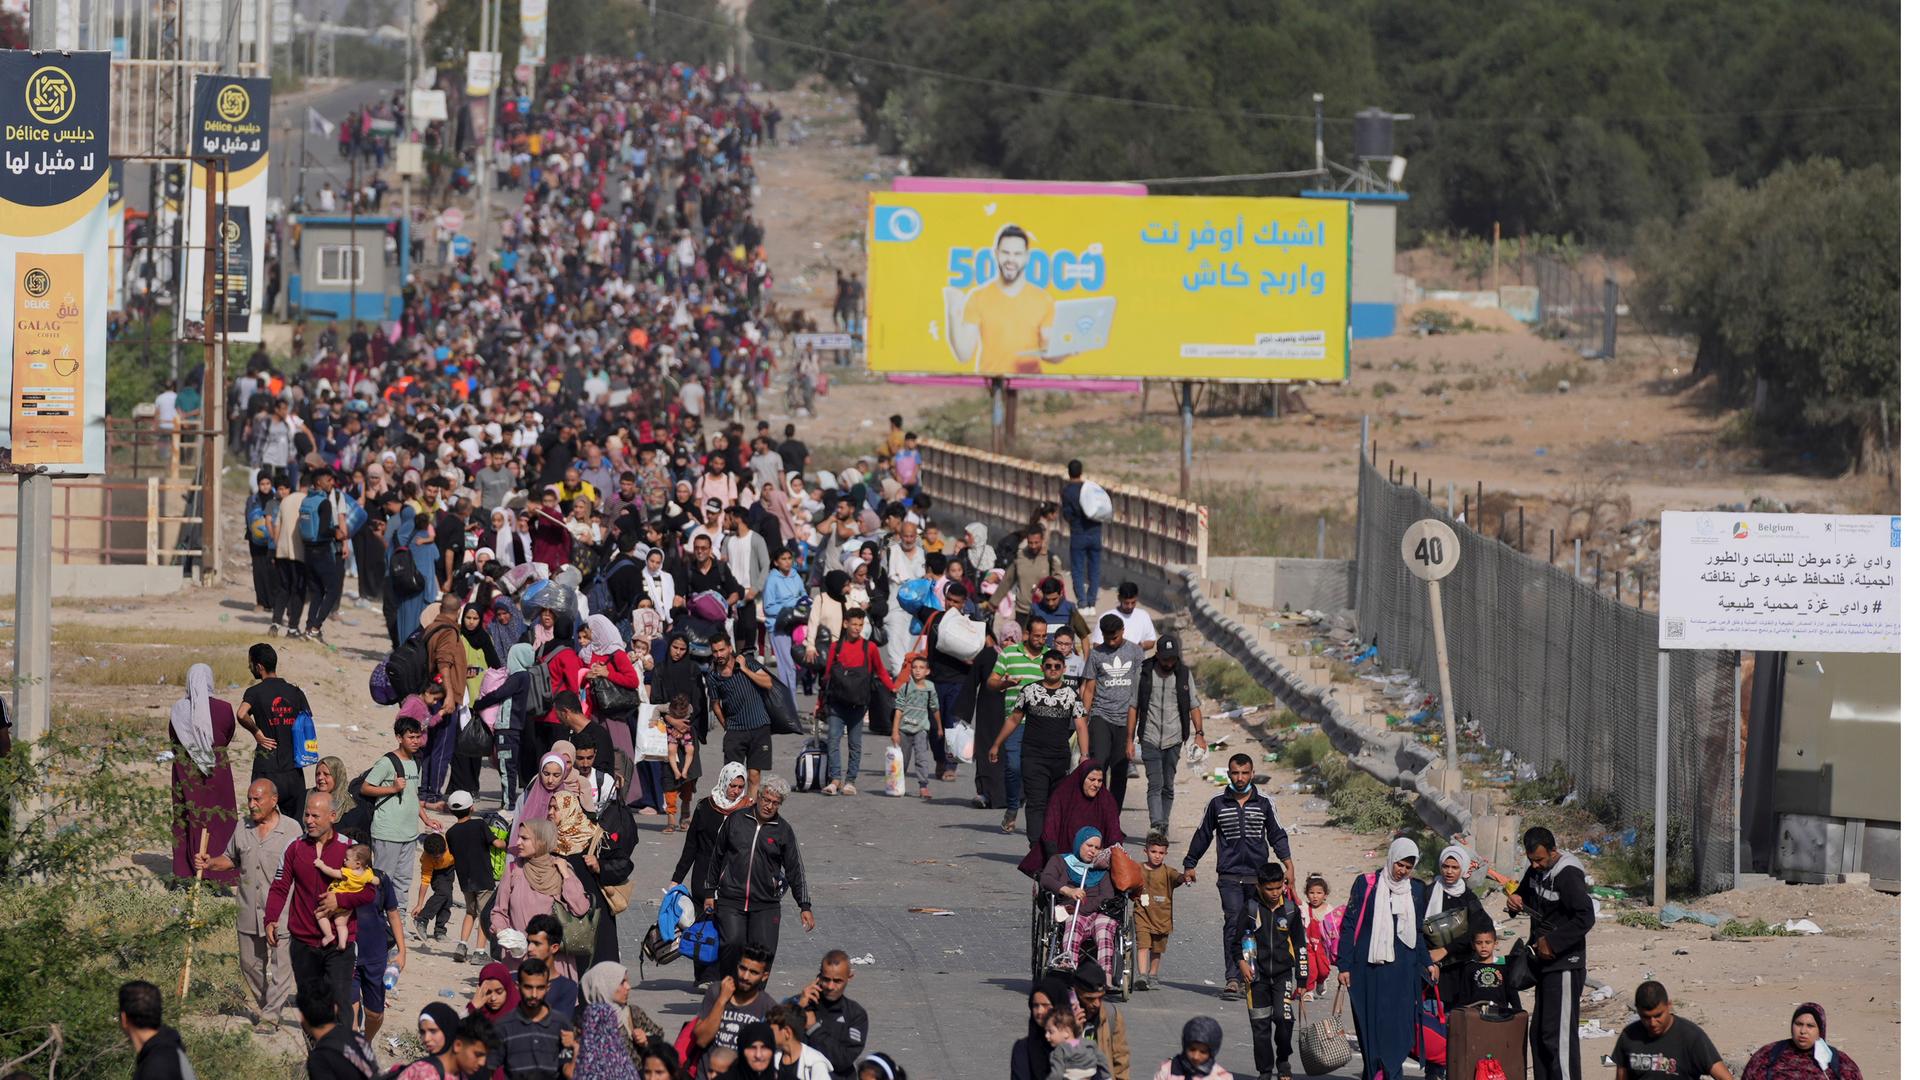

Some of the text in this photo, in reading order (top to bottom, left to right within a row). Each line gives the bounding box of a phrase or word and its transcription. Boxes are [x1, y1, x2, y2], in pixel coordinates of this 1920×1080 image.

[6, 125, 95, 143] Délice ديليس
[204, 120, 233, 132] Délice
[203, 136, 261, 154] لا مثيل لها
[6, 149, 95, 175] لا مثيل لها
[1140, 213, 1325, 253] اشبك أوفر نت
[1183, 258, 1325, 296] واربح كاش
[18, 320, 60, 331] GALAG
[1758, 523, 1794, 533] Belgium
[1415, 536, 1443, 566] 40
[1705, 551, 1892, 569] وادي غزة موطن للنباتات والطيور
[1701, 571, 1735, 583] نظافته
[1774, 574, 1798, 588] عليه
[1803, 572, 1845, 587] فلنحافظ
